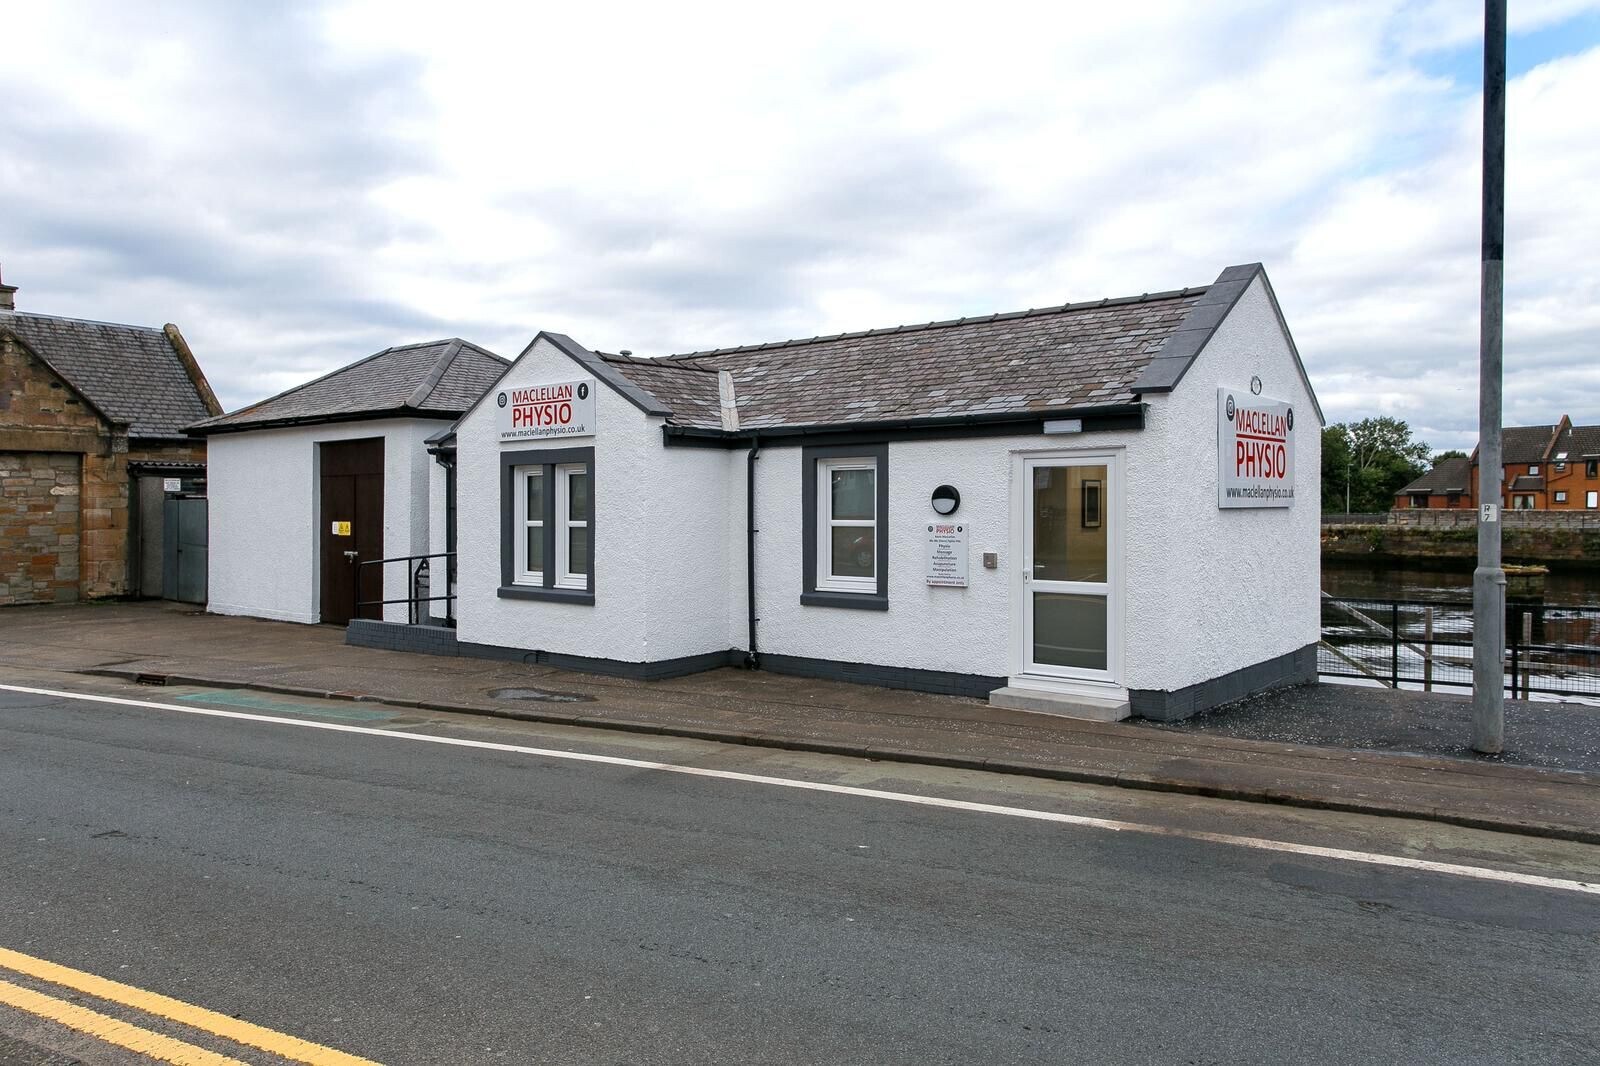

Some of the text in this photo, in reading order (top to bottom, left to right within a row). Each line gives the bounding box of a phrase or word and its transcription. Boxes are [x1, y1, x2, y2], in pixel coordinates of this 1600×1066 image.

[512, 385, 572, 404] MACLELLAN
[512, 403, 572, 428] PHYSIO
[1236, 408, 1286, 437] MACLELLAN
[501, 424, 585, 438] www.maclellanphysio.co.uk
[1236, 441, 1286, 479] PHYSIO
[1226, 485, 1294, 501] www.maclellanphysio.co.uk
